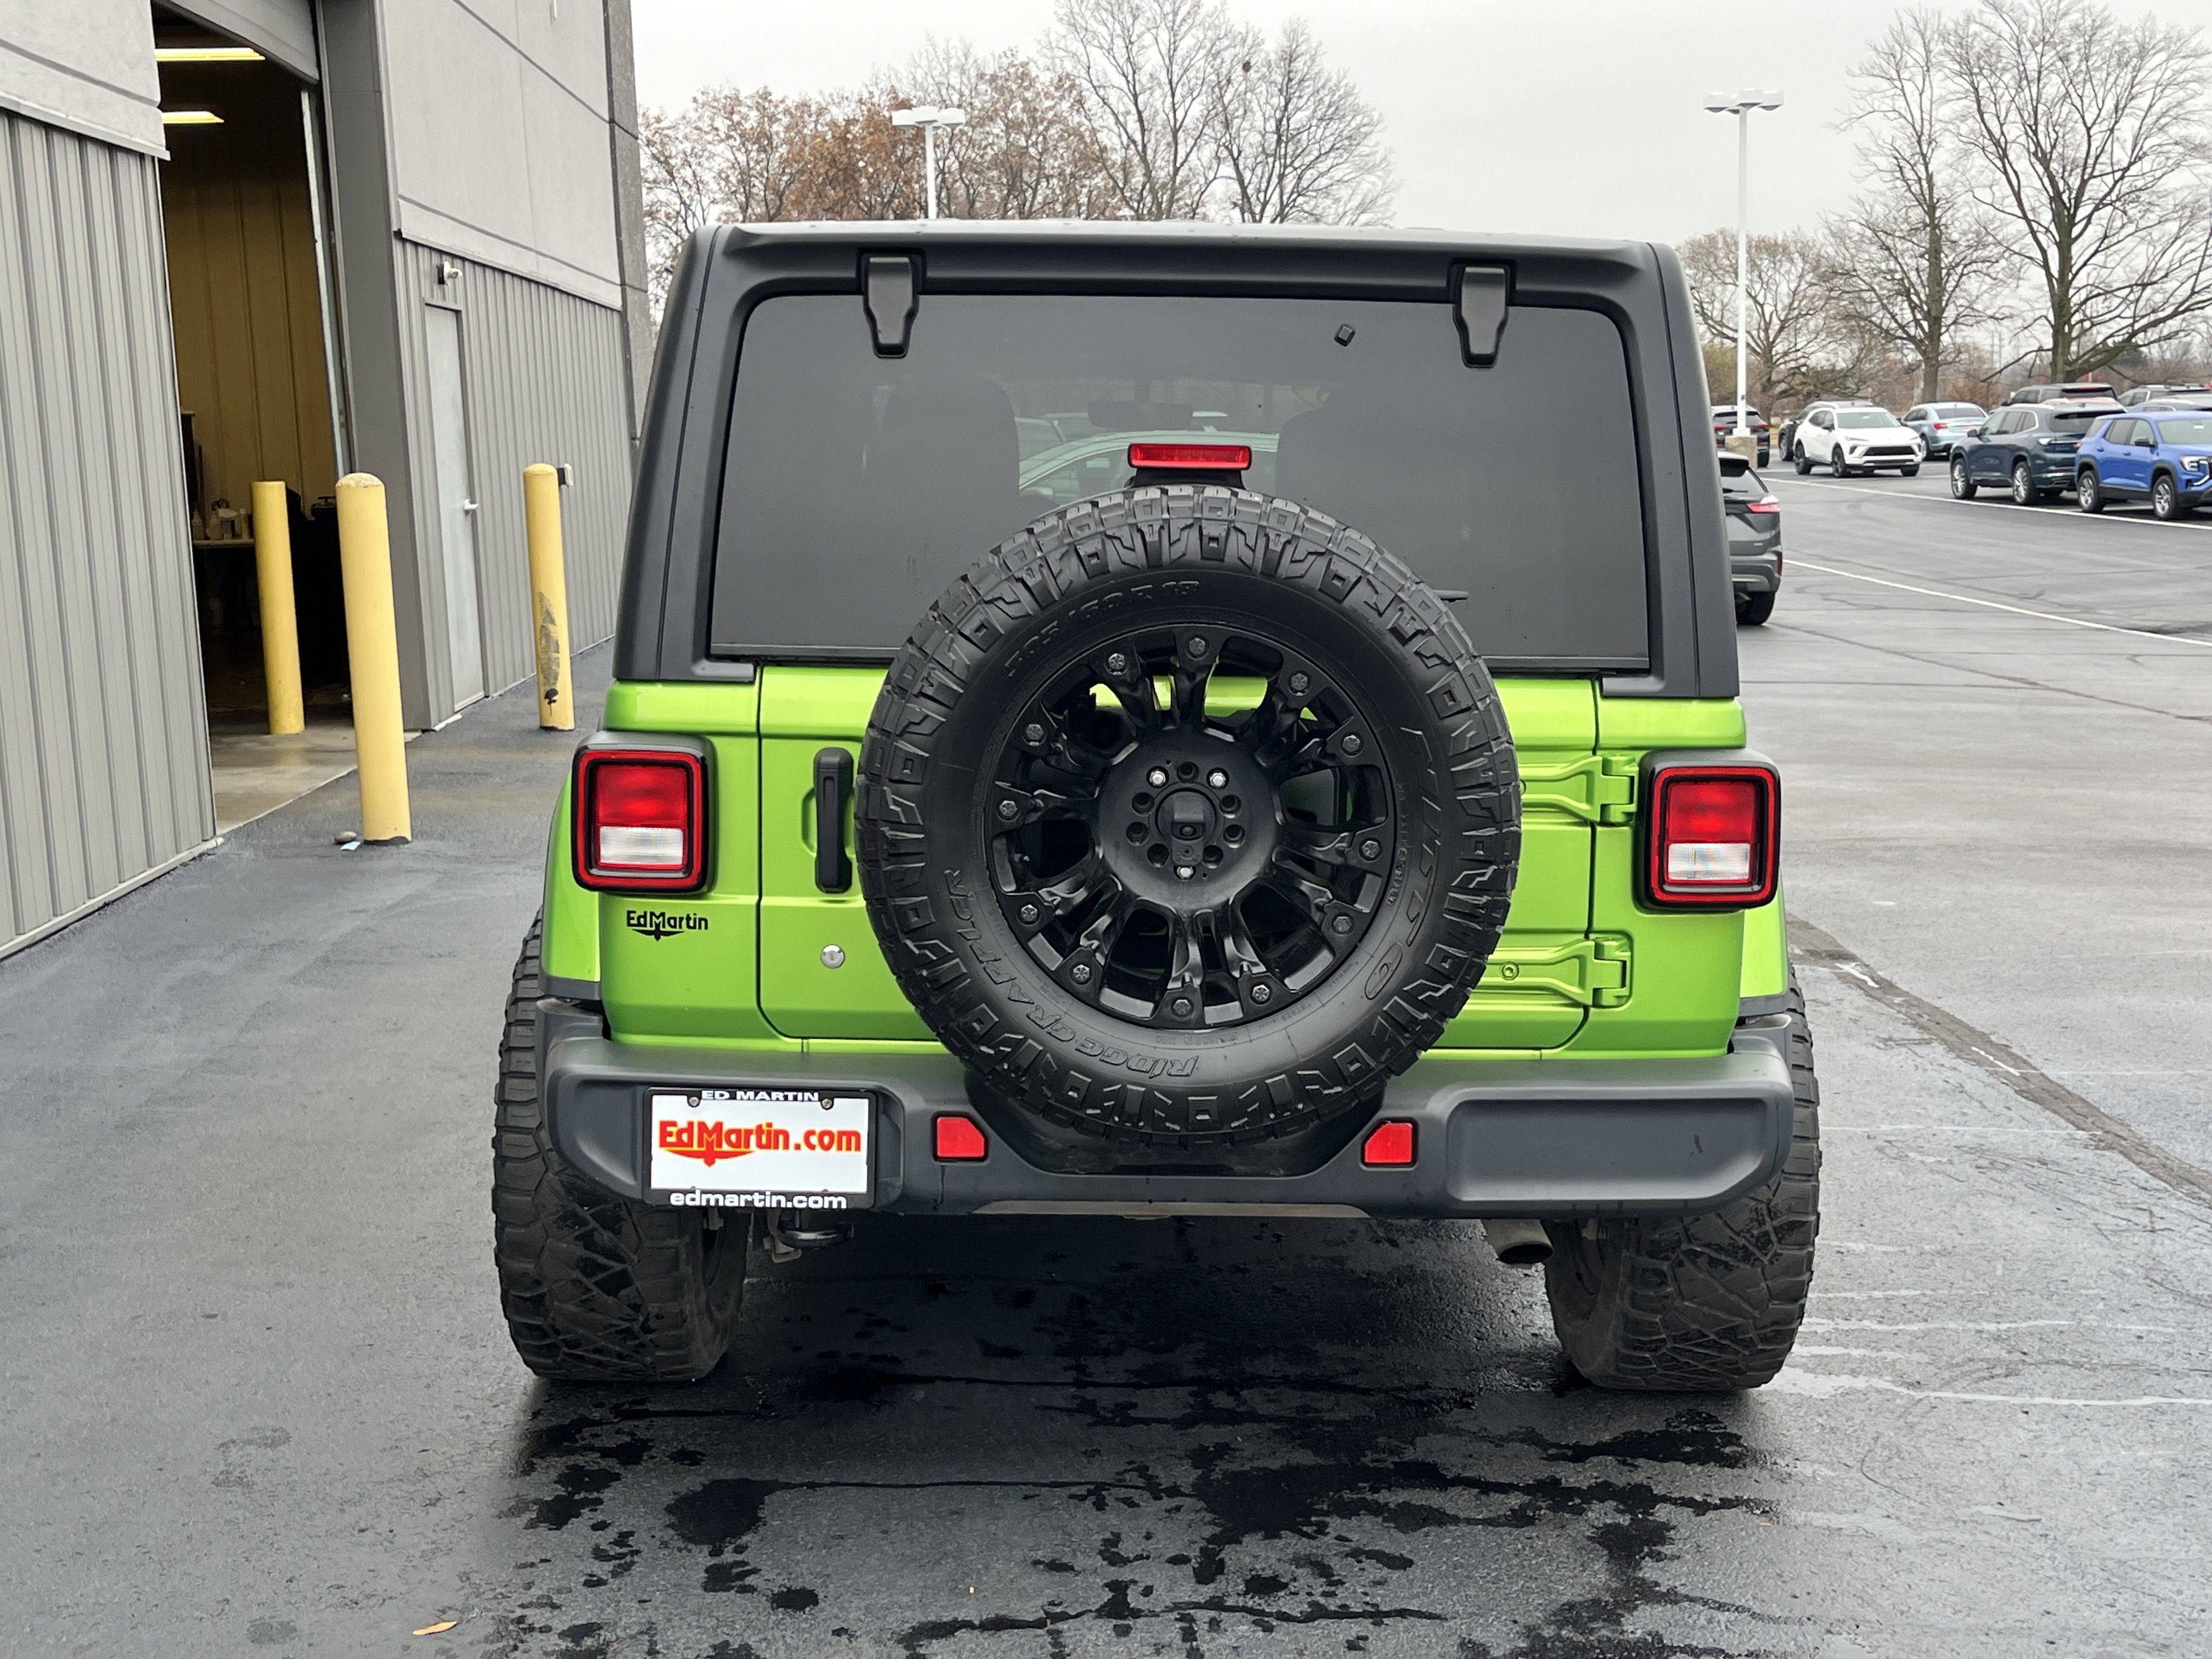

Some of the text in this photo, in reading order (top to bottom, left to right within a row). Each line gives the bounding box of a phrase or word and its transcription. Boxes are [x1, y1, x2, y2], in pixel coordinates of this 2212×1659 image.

[626, 910, 709, 931] EdMartin
[944, 868, 1075, 1042] GRAPPLER
[1076, 1040, 1199, 1079] RIDGE
[702, 1090, 819, 1102] ED MARTIN
[670, 1189, 847, 1210] edmartin.com
